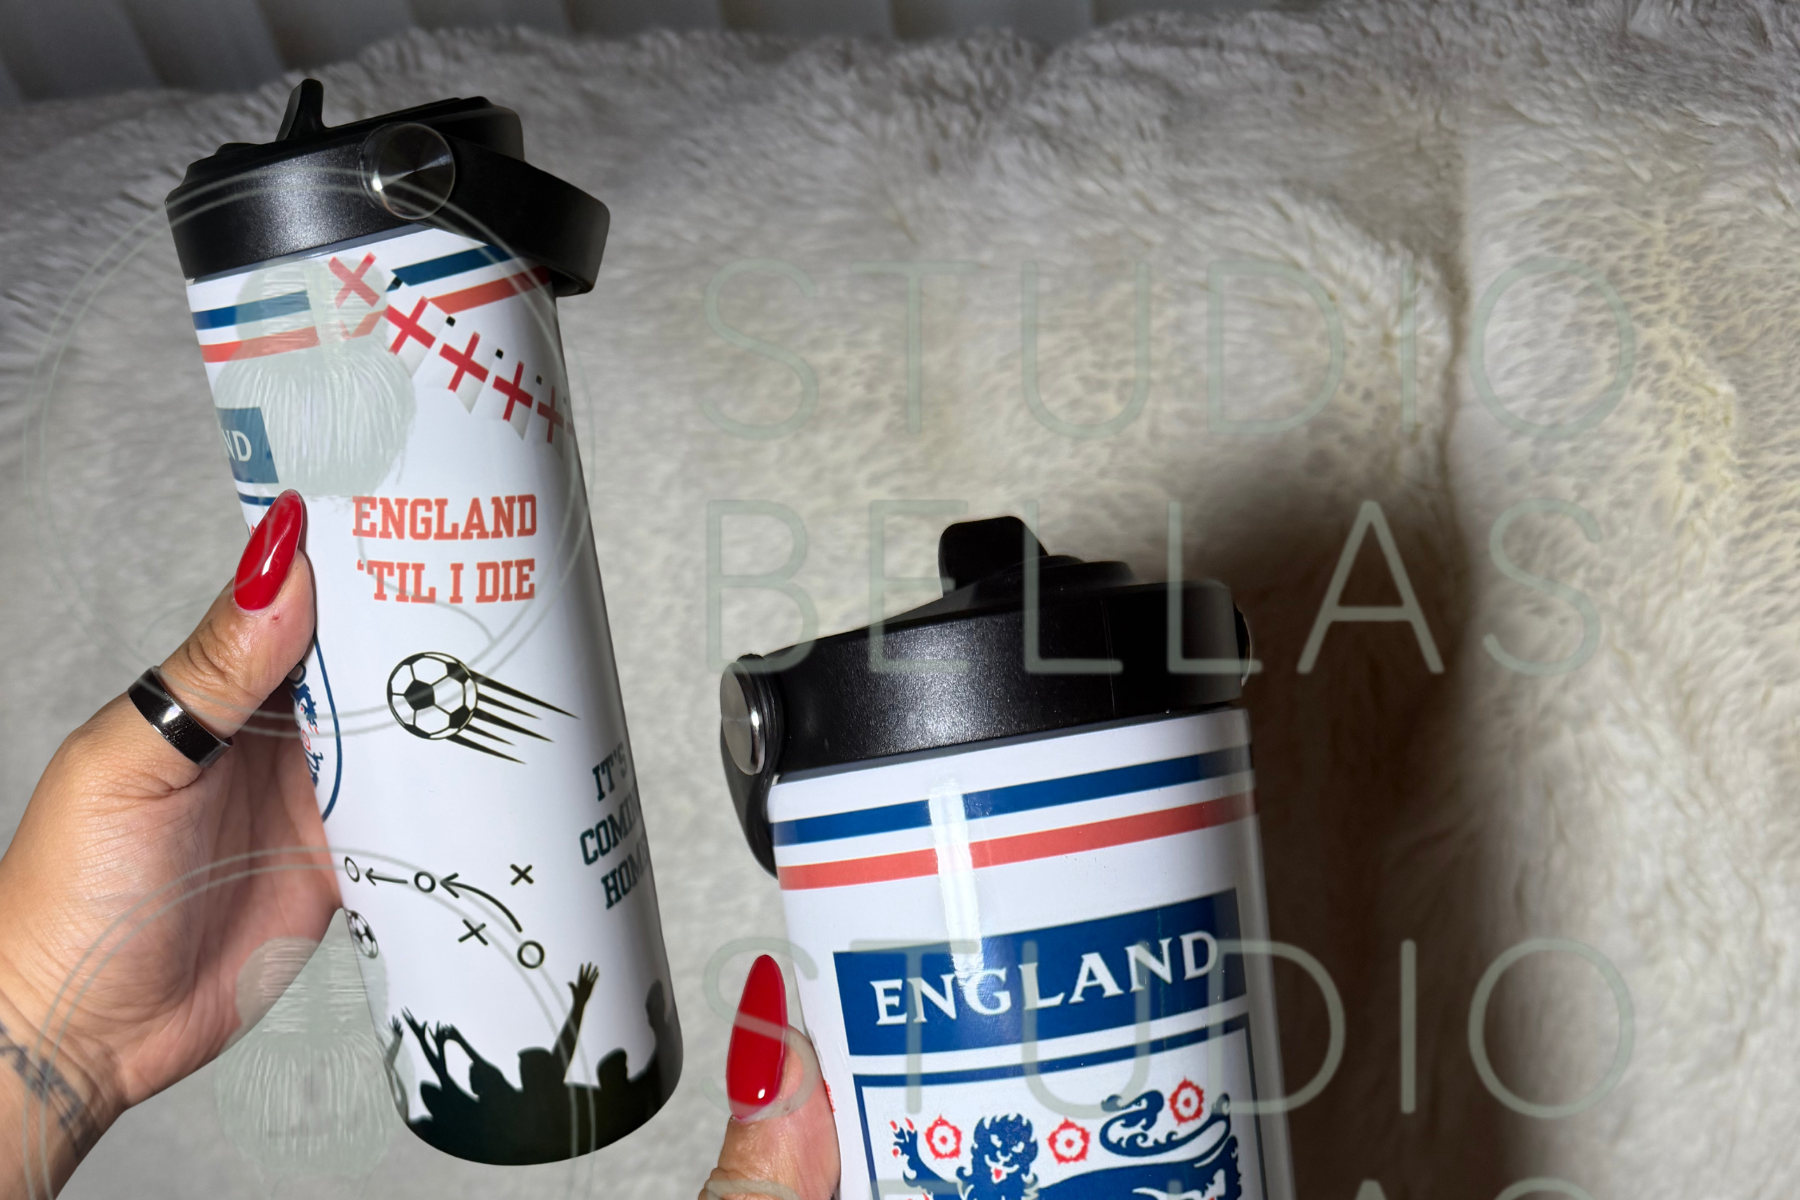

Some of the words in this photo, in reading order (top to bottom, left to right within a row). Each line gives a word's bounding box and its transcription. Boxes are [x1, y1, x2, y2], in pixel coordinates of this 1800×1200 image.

[352, 494, 537, 541] ENGLAND
[449, 562, 464, 604] I
[475, 558, 536, 604] DIE
[592, 741, 628, 802] IT'S
[579, 785, 641, 866] COMIN
[869, 930, 1219, 1027] ENGLAND
